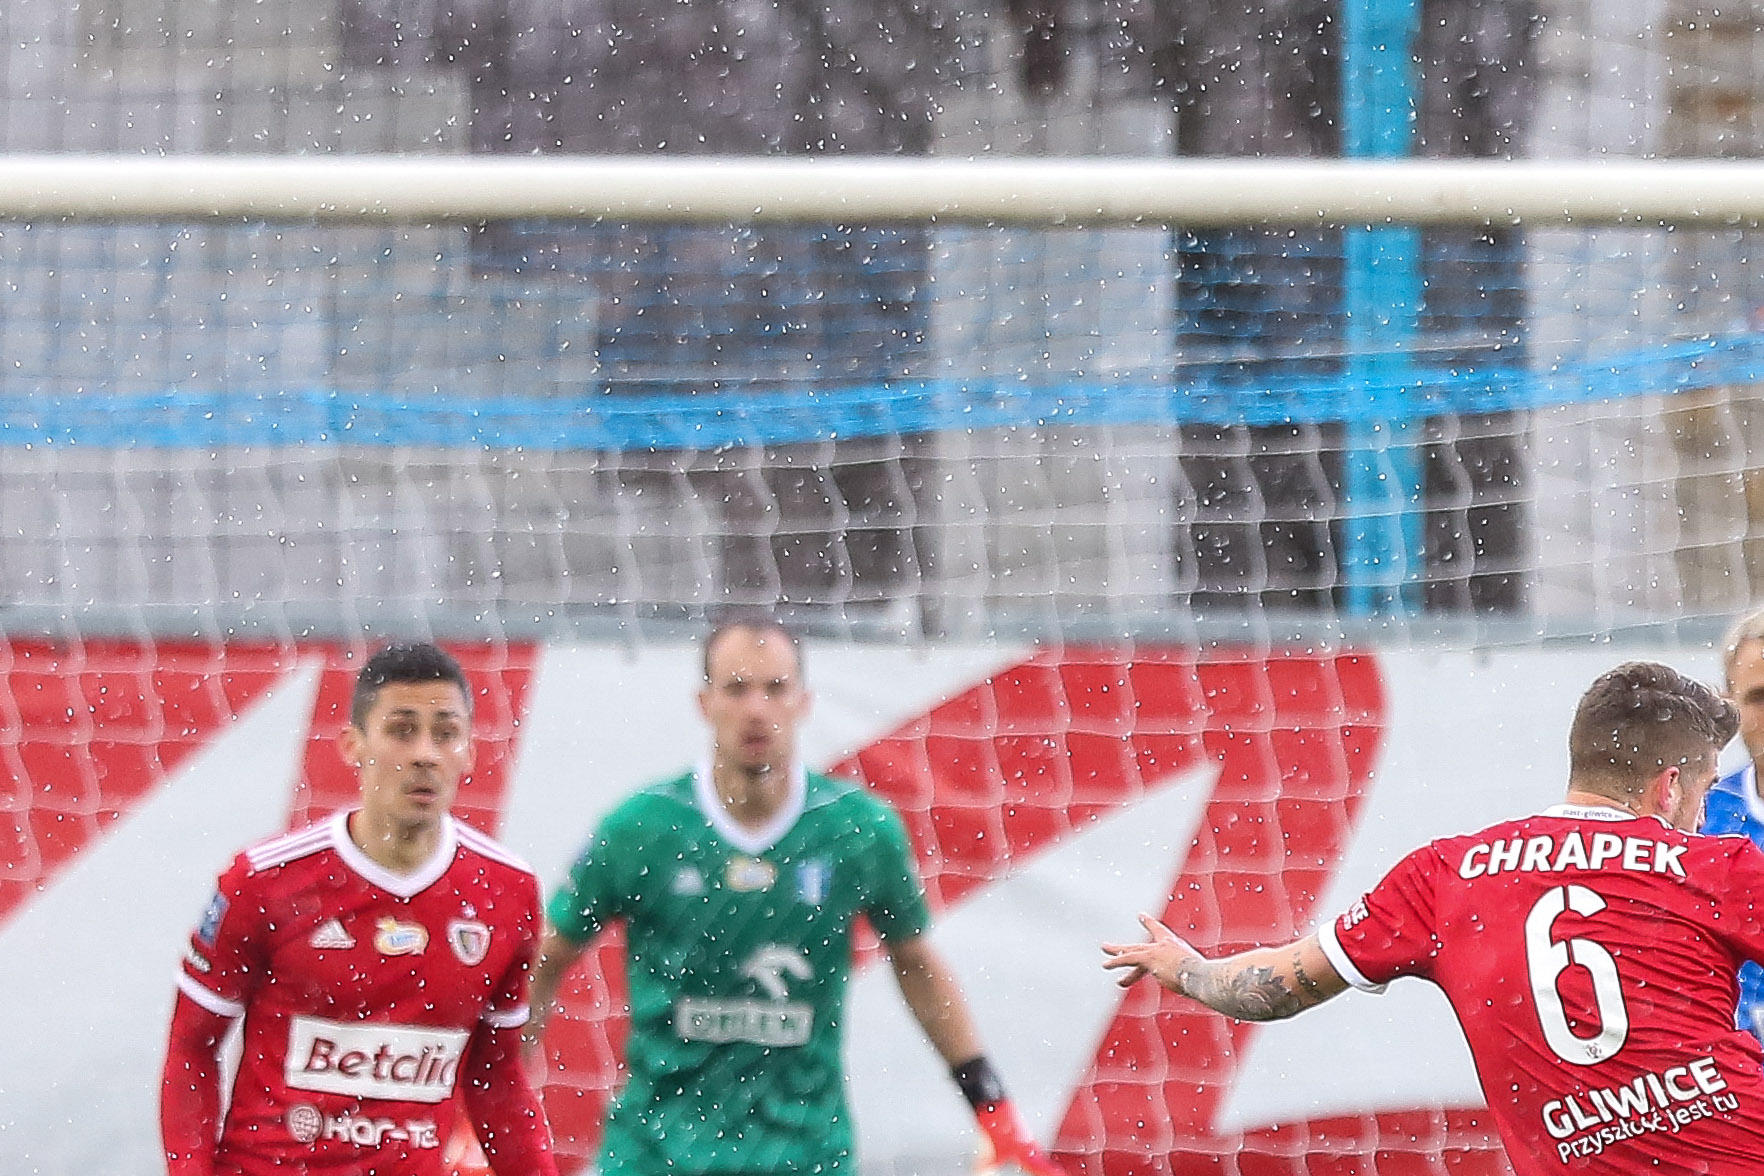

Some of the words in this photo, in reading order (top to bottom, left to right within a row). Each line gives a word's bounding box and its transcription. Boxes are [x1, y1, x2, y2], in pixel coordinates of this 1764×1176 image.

[1458, 832, 1688, 879] CHRAPEK
[1524, 884, 1629, 1065] 6
[1541, 1056, 1728, 1139] GLIWICE
[1665, 1101, 1713, 1133] jest
[1712, 1093, 1739, 1112] tu
